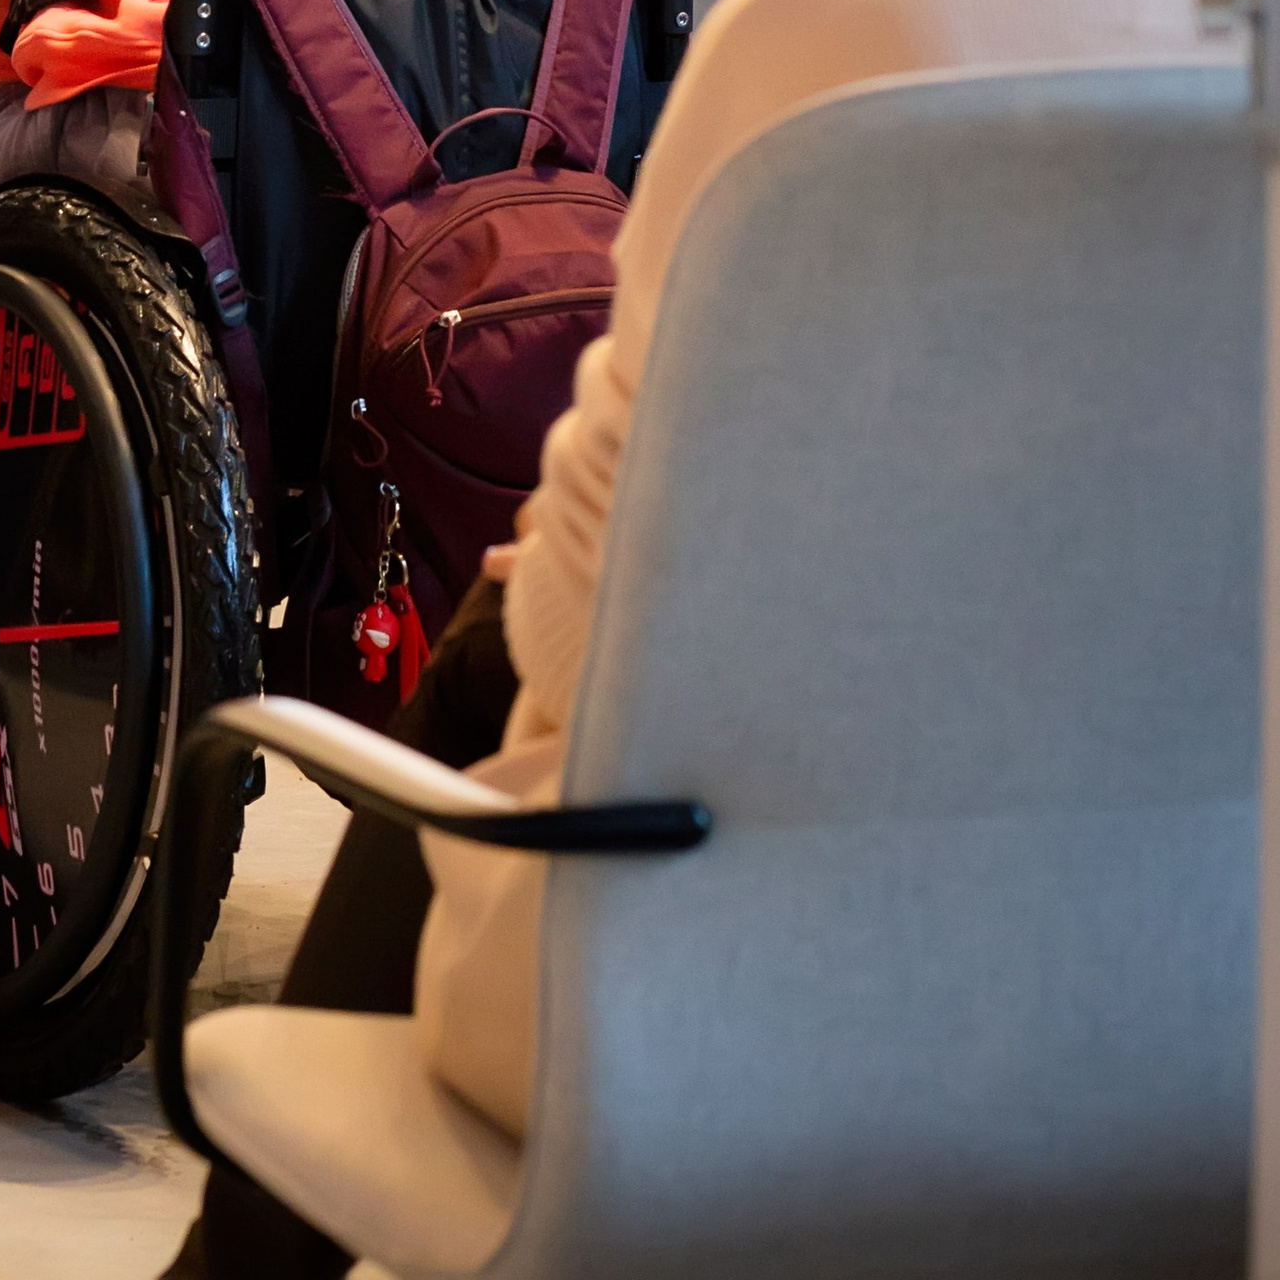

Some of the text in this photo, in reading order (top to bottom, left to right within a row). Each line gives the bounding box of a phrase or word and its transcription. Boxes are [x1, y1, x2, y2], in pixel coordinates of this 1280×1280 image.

[0, 330, 14, 404] GEAR
[65, 823, 86, 863] 5
[1, 873, 20, 908] 7
[36, 862, 56, 896] 6
